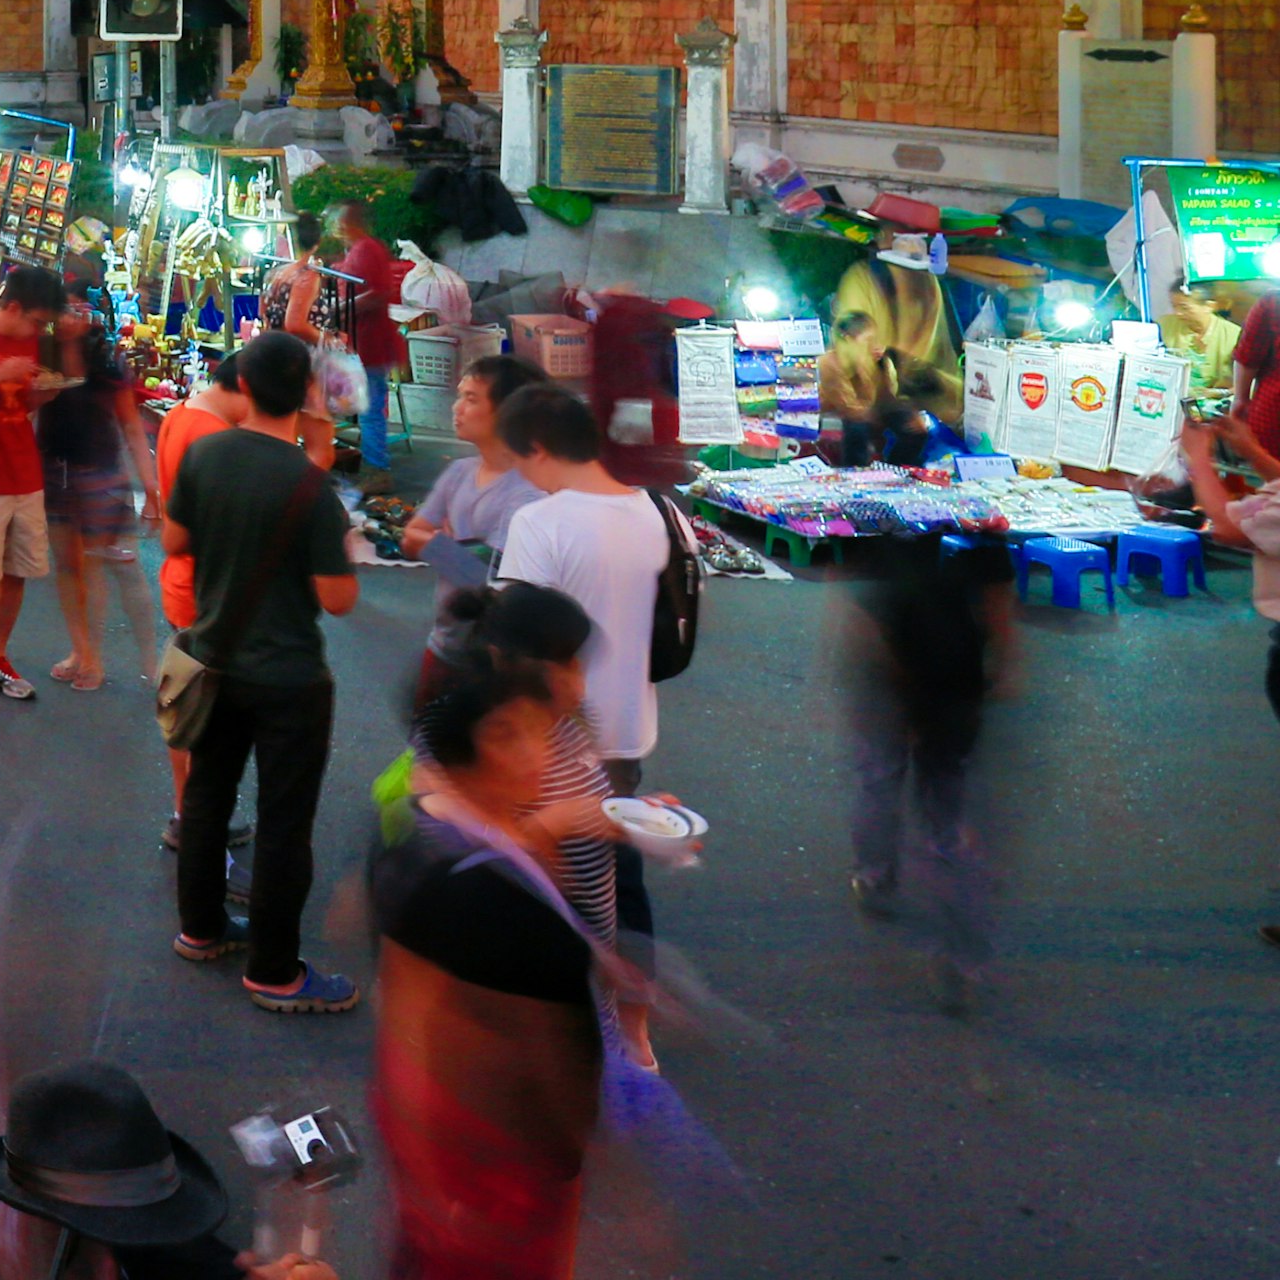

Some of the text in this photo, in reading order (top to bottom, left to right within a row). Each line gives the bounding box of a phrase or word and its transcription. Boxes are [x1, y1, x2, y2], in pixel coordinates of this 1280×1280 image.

[1182, 199, 1217, 209] PAPAYA
[1220, 198, 1251, 209] SALAD
[799, 461, 823, 476] 25
